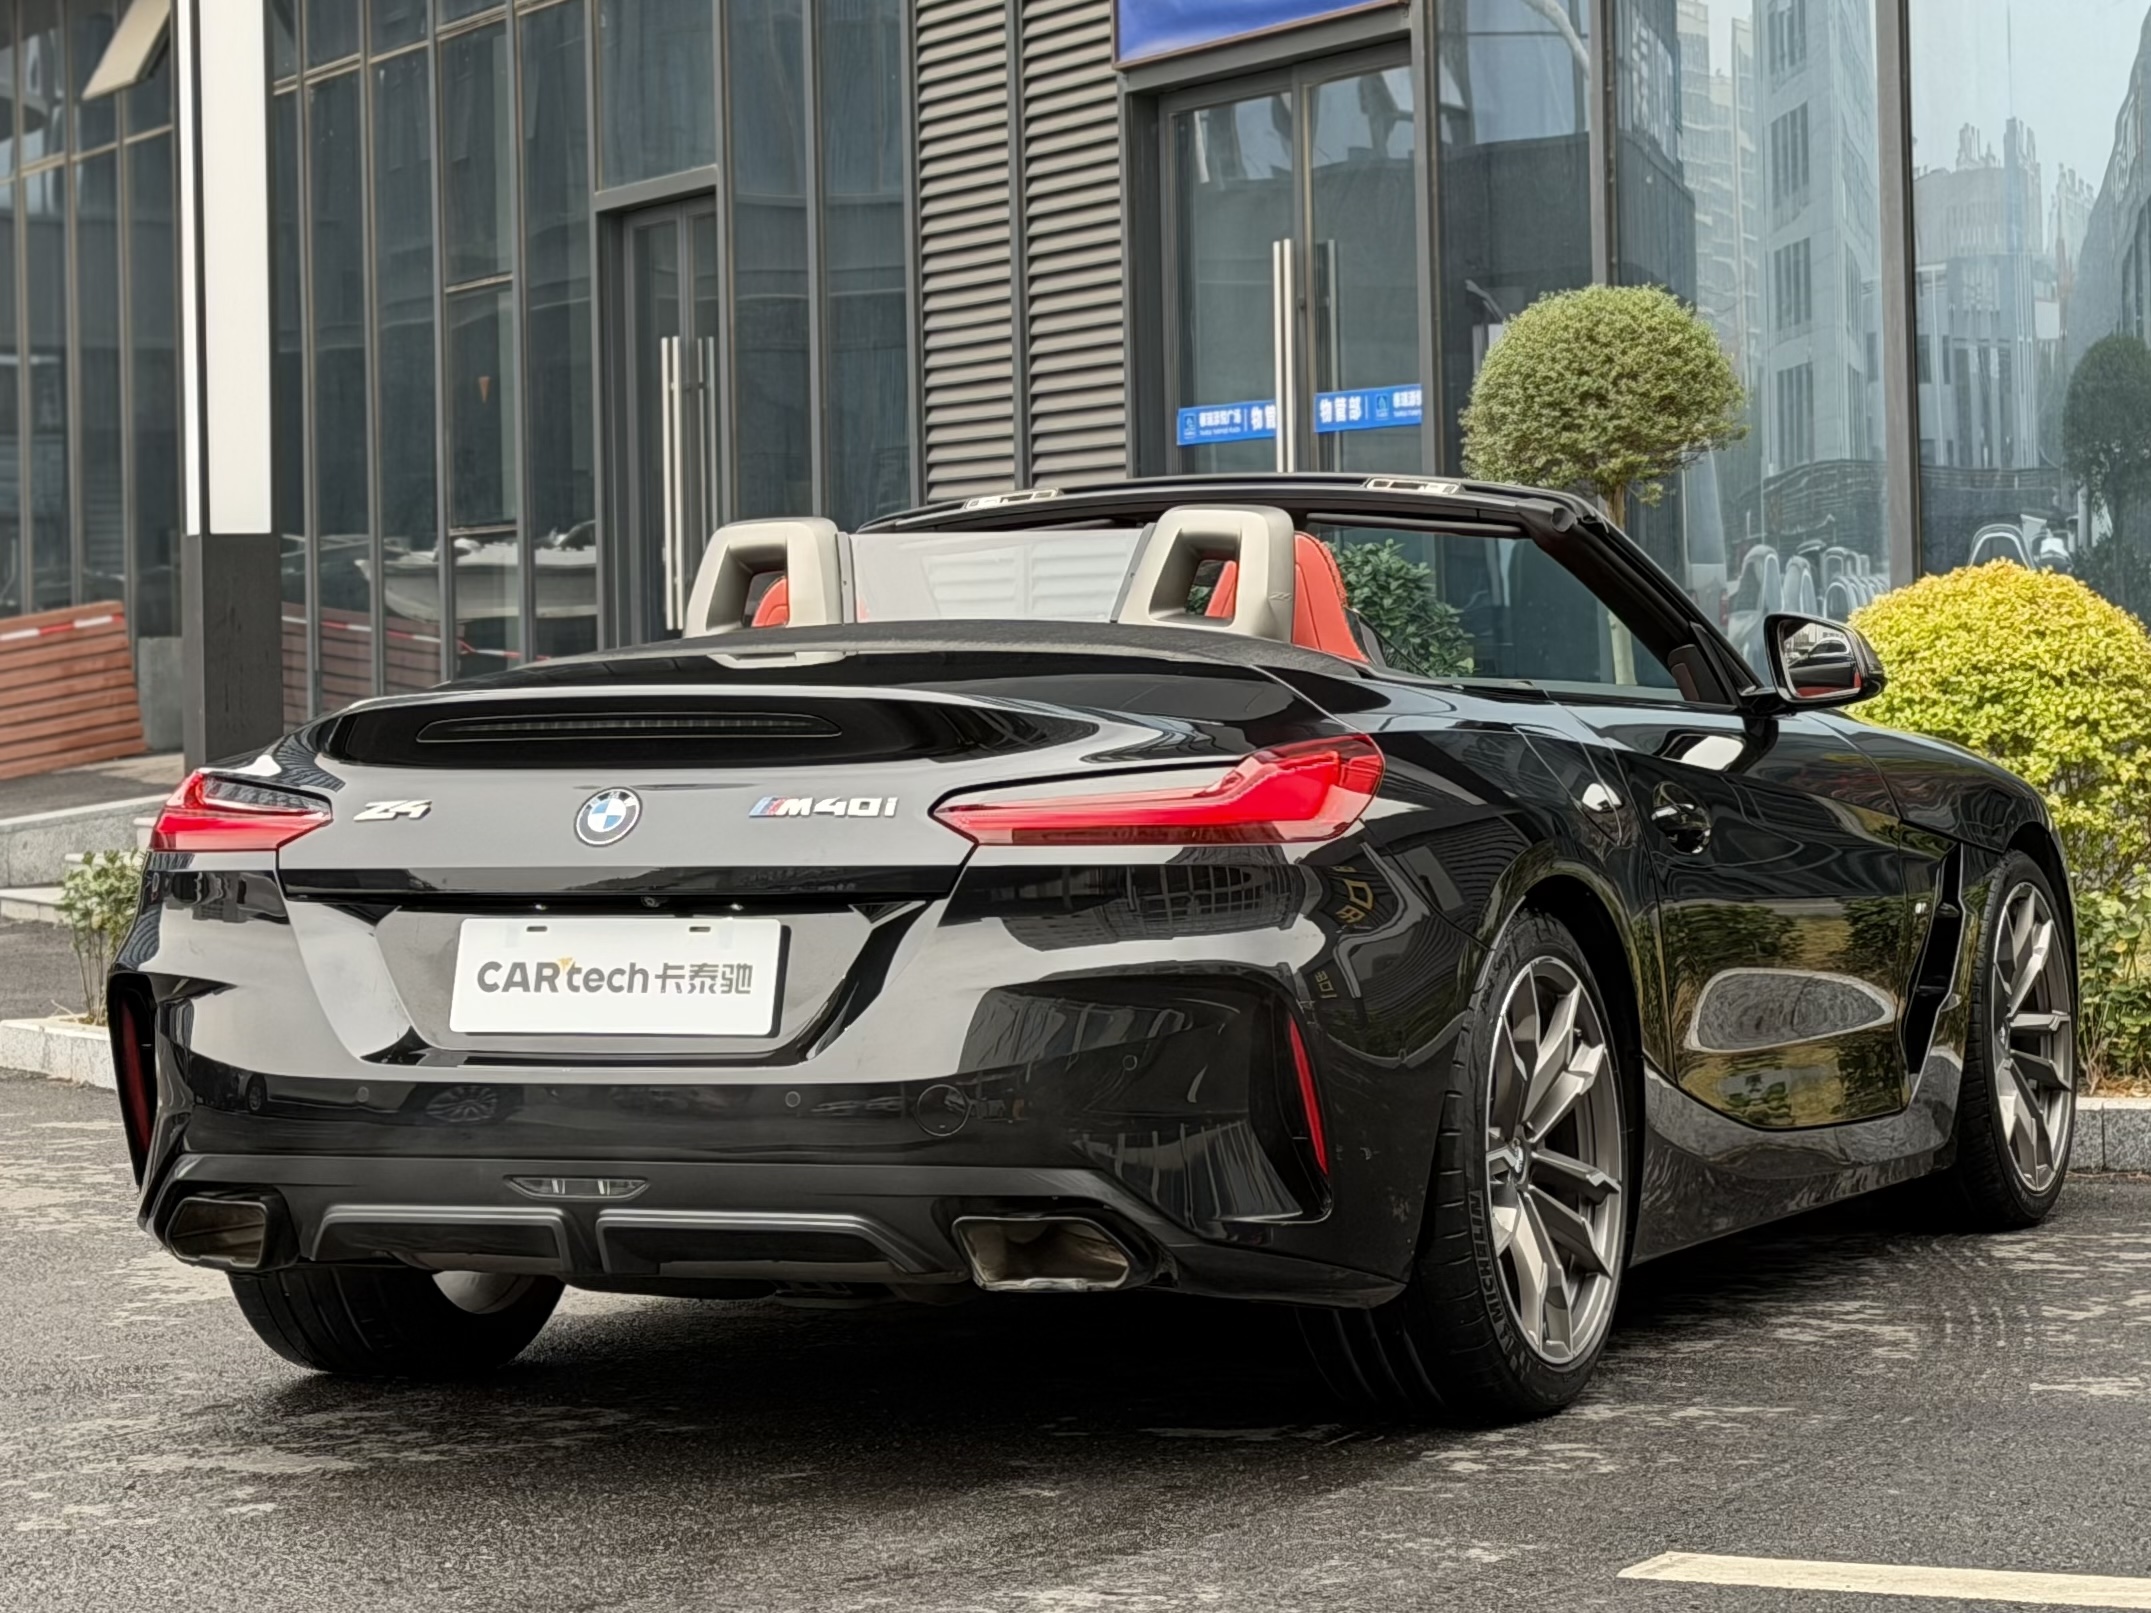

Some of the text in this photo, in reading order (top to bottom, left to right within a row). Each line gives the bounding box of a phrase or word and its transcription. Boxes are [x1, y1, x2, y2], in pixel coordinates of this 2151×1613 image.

[353, 799, 432, 822] Z4
[772, 796, 899, 818] M40i
[476, 959, 754, 995] CARtech 卡泰驰
[1468, 1190, 1505, 1323] MICHELIN
